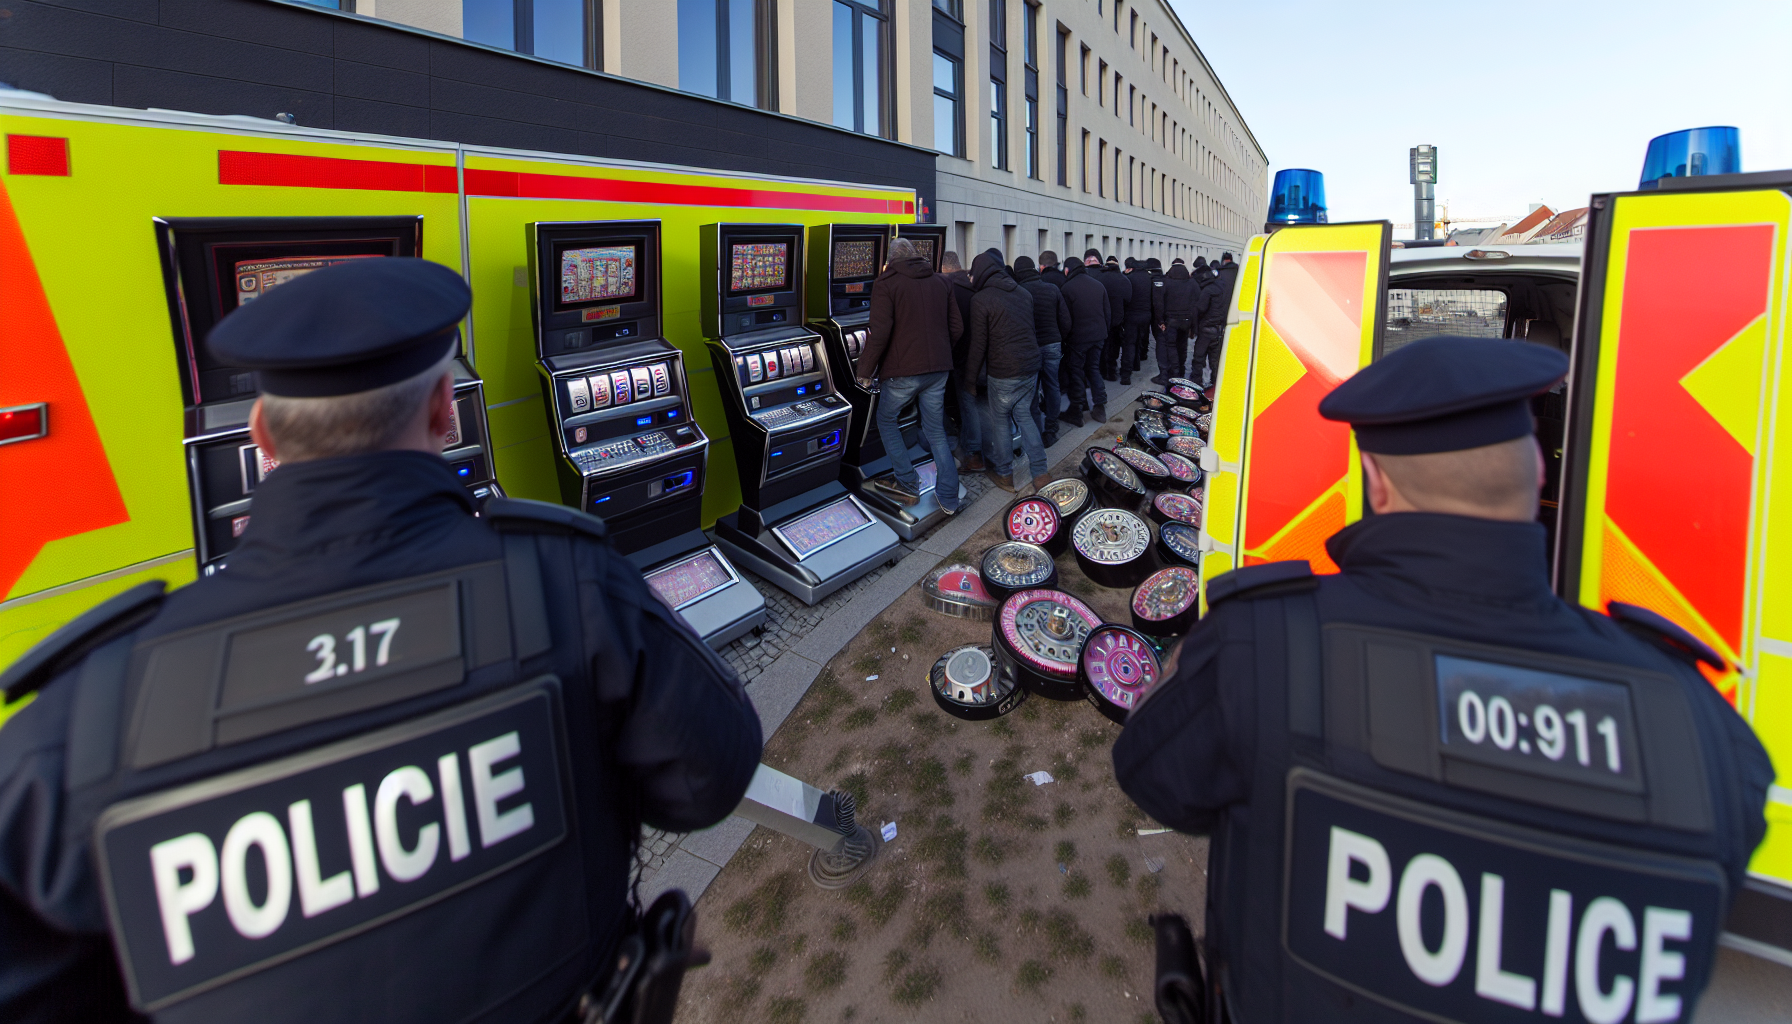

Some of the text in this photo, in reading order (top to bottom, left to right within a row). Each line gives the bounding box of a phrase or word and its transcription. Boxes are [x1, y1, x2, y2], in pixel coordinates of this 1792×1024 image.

[1457, 689, 1622, 774] 00:911
[151, 731, 535, 966] POLICIE
[1324, 825, 1693, 1024] POLICE
